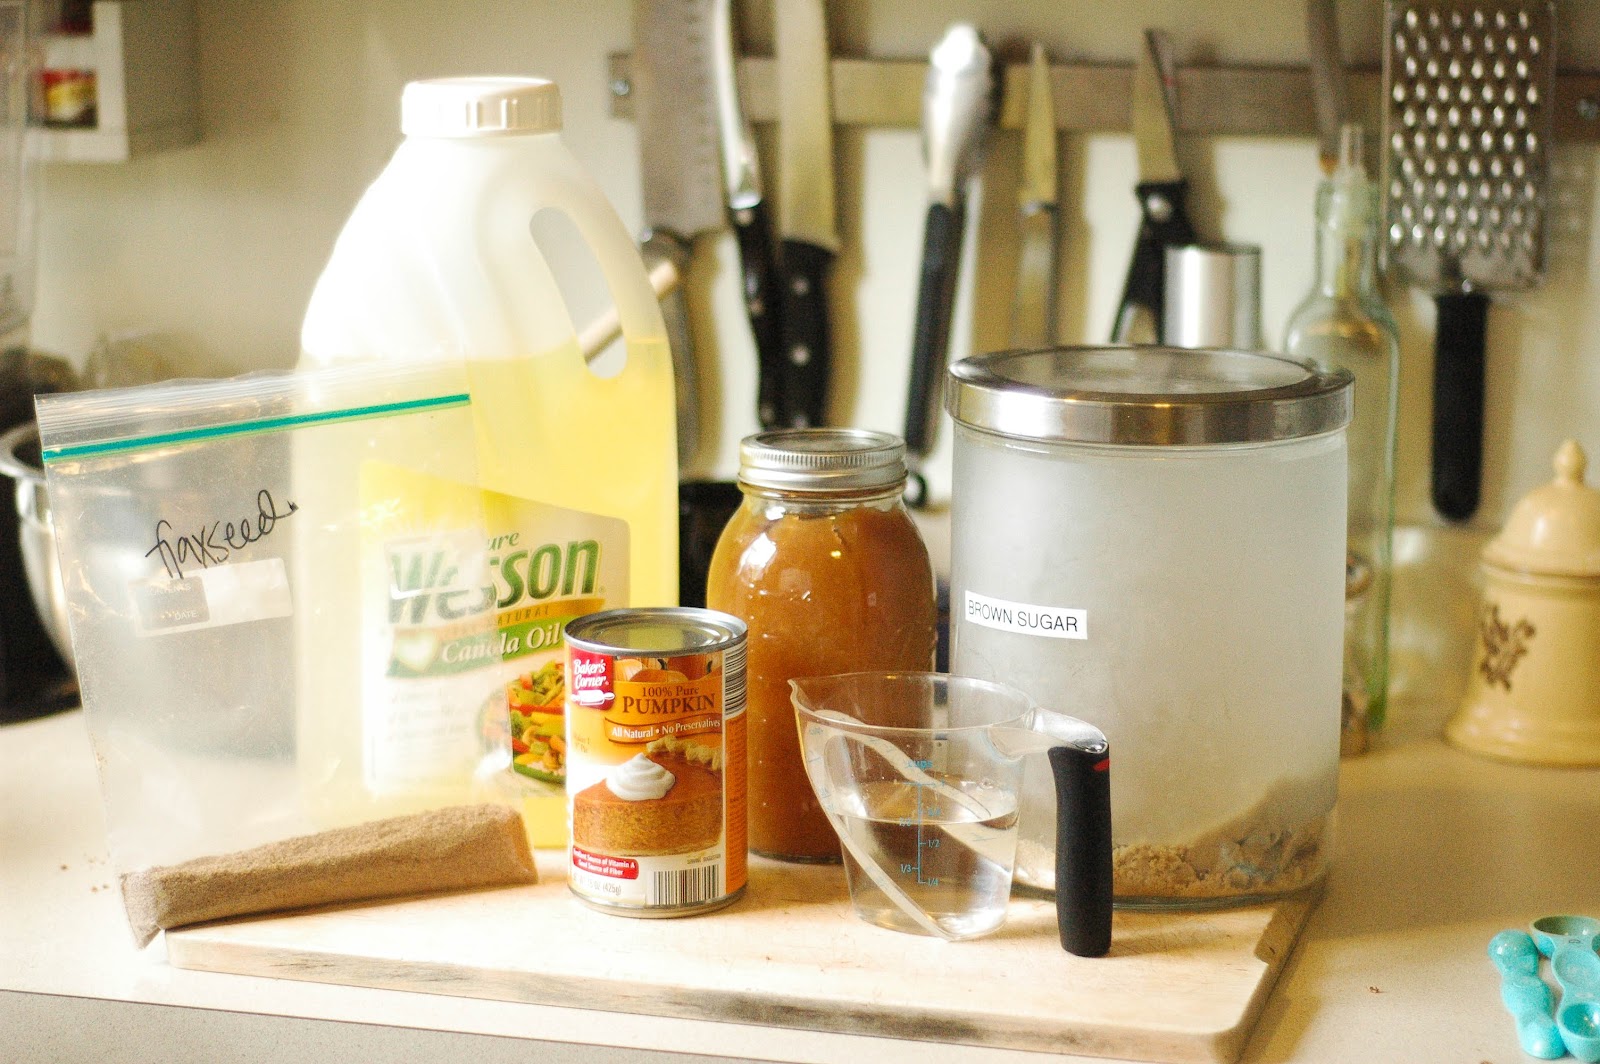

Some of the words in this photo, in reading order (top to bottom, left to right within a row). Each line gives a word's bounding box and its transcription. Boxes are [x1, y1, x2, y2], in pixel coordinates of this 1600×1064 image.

[486, 532, 519, 551] ure
[968, 599, 1013, 625] BROWN
[1017, 610, 1078, 633] SUGAR
[526, 621, 562, 650] Oil
[573, 658, 606, 675] Baker's
[574, 674, 607, 690] Corner
[642, 686, 673, 698] 100%
[676, 685, 700, 697] Pure
[622, 693, 716, 715] PUMPKIN
[611, 726, 623, 737] All
[624, 726, 654, 739] Natural
[661, 724, 674, 736] No
[675, 717, 721, 733] Preservatives
[608, 859, 630, 868] Vitamin
[630, 861, 636, 869] A
[900, 863, 913, 874] 1/3
